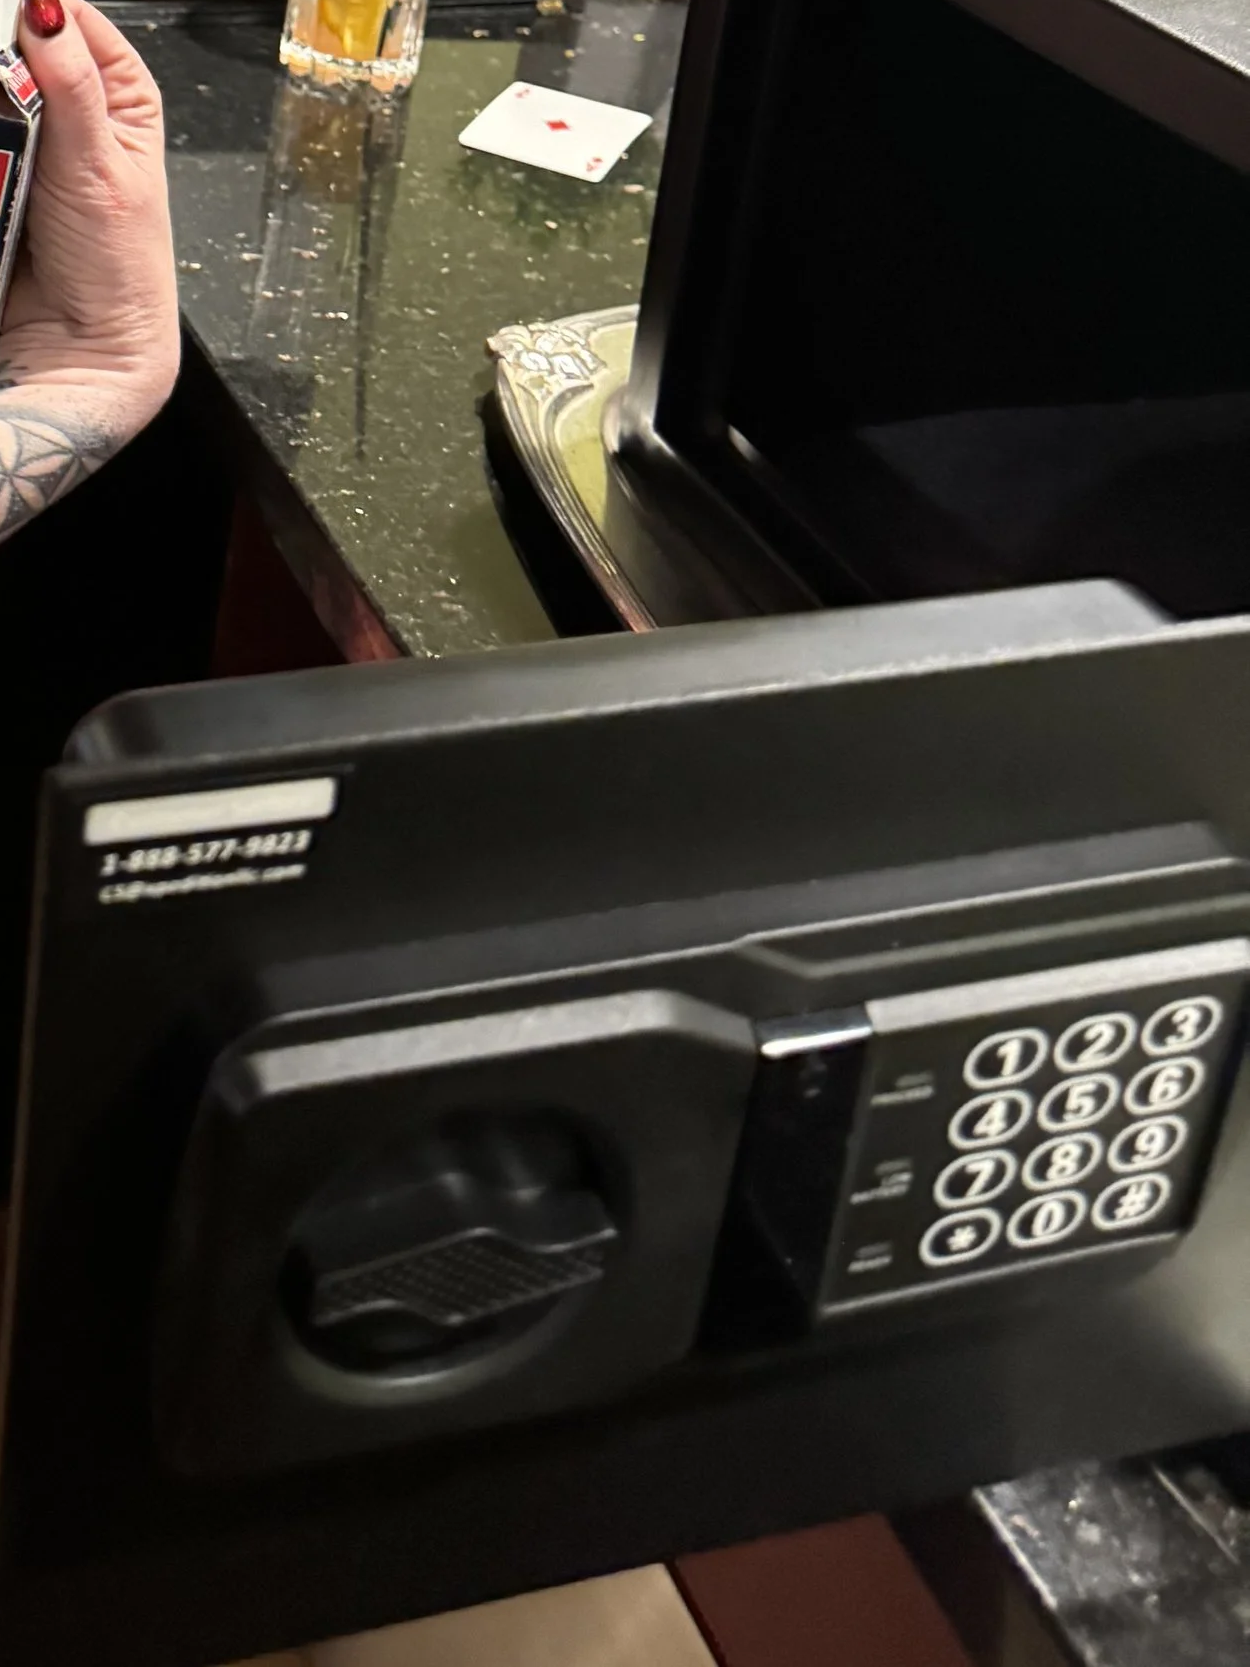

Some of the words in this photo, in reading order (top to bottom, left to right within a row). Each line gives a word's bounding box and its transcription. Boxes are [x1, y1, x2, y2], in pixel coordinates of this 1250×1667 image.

[994, 1038, 1023, 1078] 1
[1075, 1025, 1117, 1066] 2
[1164, 1006, 1203, 1048] 3
[971, 1099, 1008, 1140] 4
[1063, 1083, 1099, 1122] 5
[1147, 1065, 1183, 1107] 6
[963, 1159, 996, 1197] 7
[1045, 1142, 1081, 1181] 8
[1132, 1124, 1167, 1164] 9
[1030, 1200, 1063, 1238] 0
[1112, 1183, 1152, 1223] #
